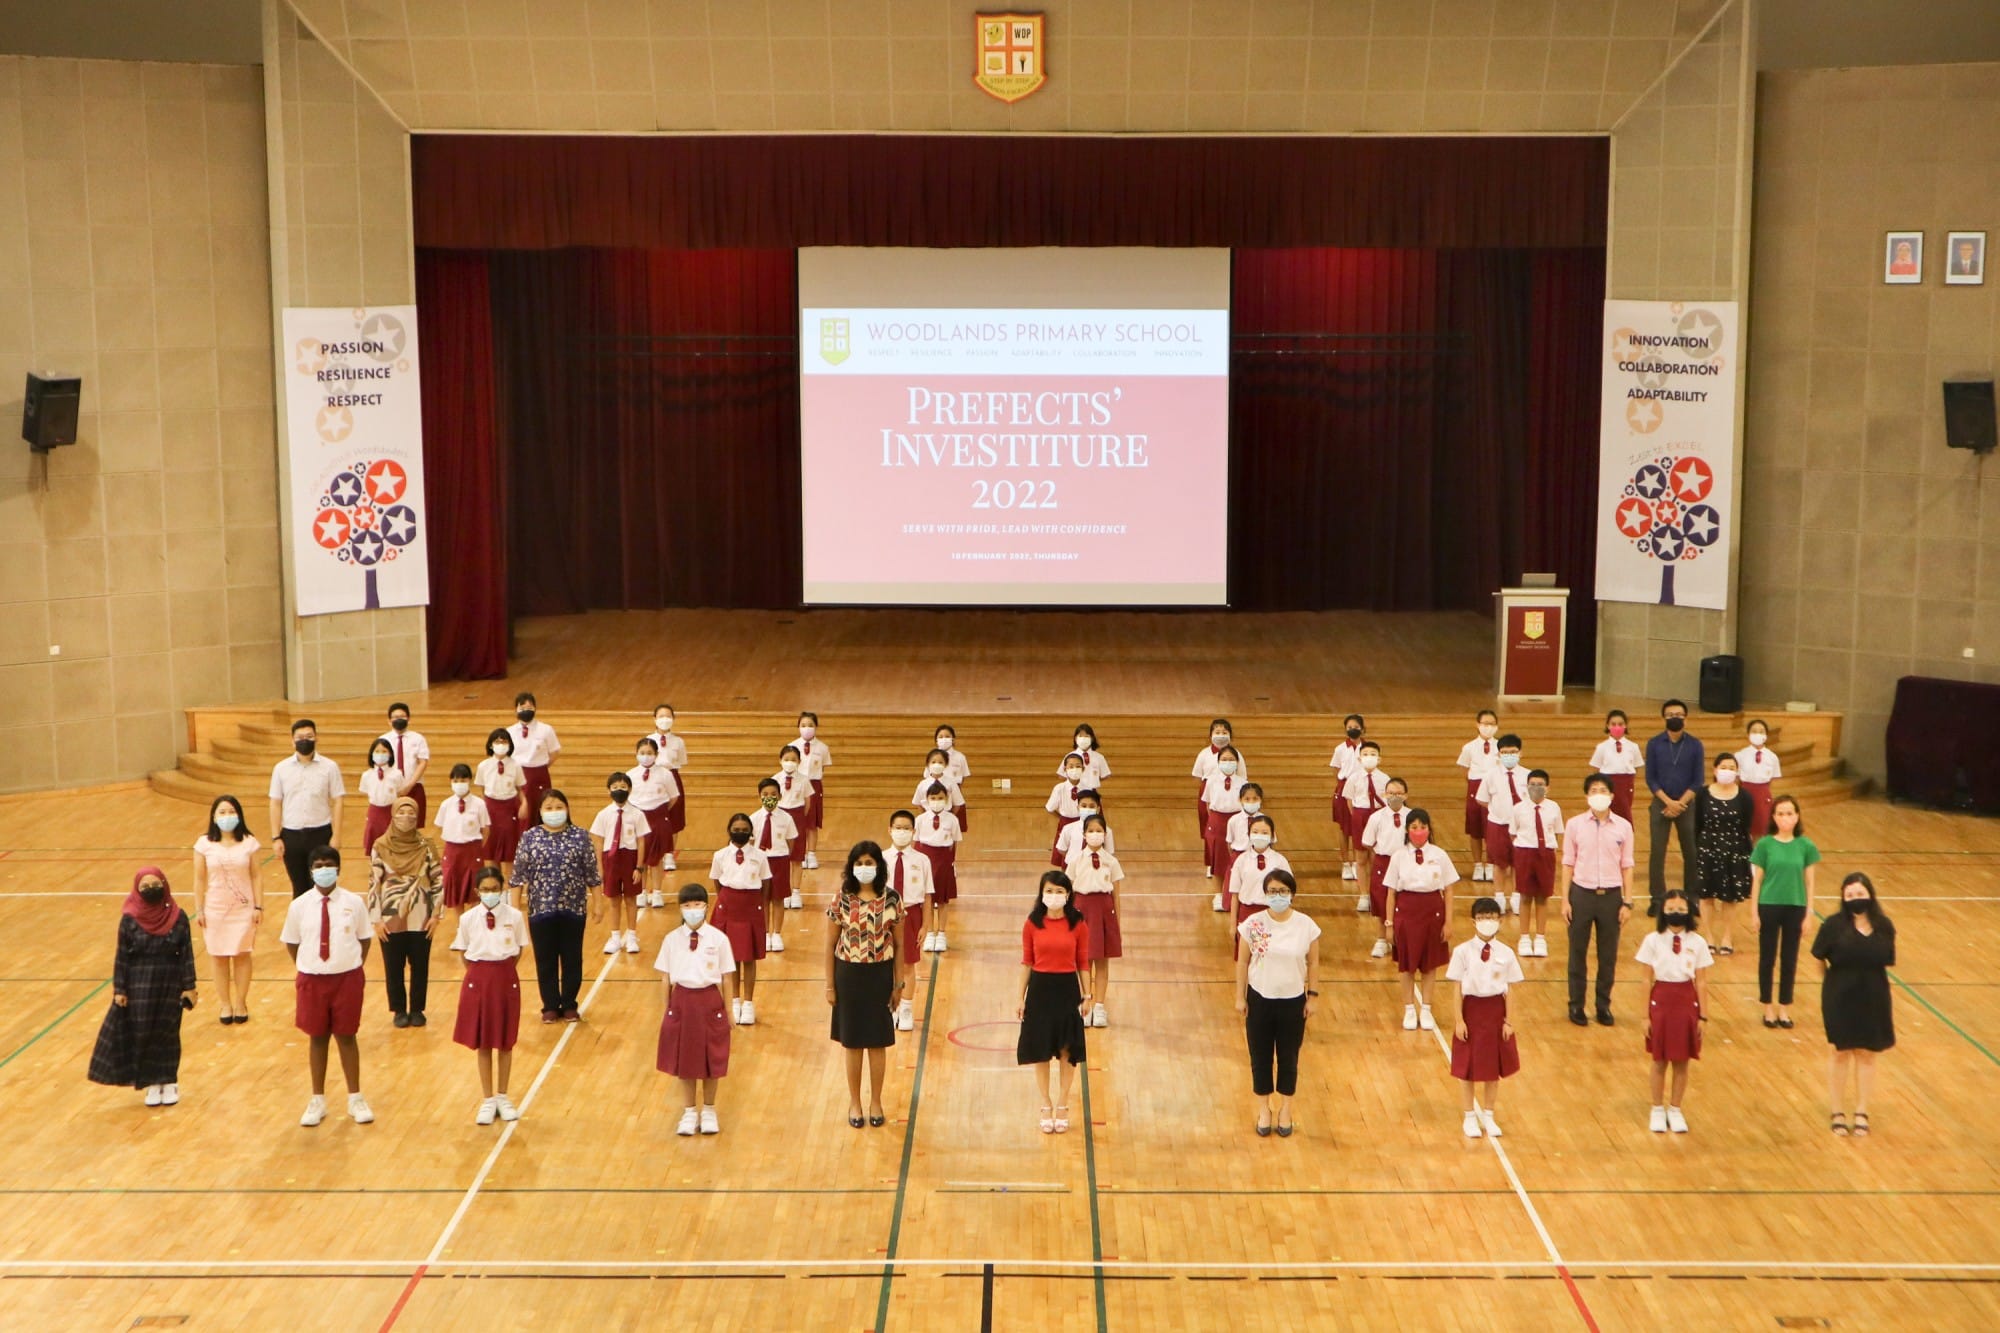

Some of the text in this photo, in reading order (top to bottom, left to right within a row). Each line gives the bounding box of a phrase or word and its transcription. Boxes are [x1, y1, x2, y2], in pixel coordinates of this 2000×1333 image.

[1014, 27, 1031, 39] WDP
[867, 323, 1203, 343] WOODLANDS PRIMARY SCHOOL
[321, 341, 384, 355] PASSION
[1629, 334, 1709, 348] INNOVATION
[317, 367, 391, 382] RESILIENCE
[1618, 361, 1719, 375] COLLABORATION
[327, 394, 383, 407] RESPECT
[1627, 388, 1708, 402] ADAPTABILITY
[879, 428, 1149, 467] INVESTITURE
[971, 479, 1058, 508] 2022
[903, 524, 1128, 535] SERVE WITH PRIDE, LEAD WITH CONFIDENCE
[962, 552, 1007, 560] FEBRUARY
[1034, 552, 1080, 560] THURSDAY
